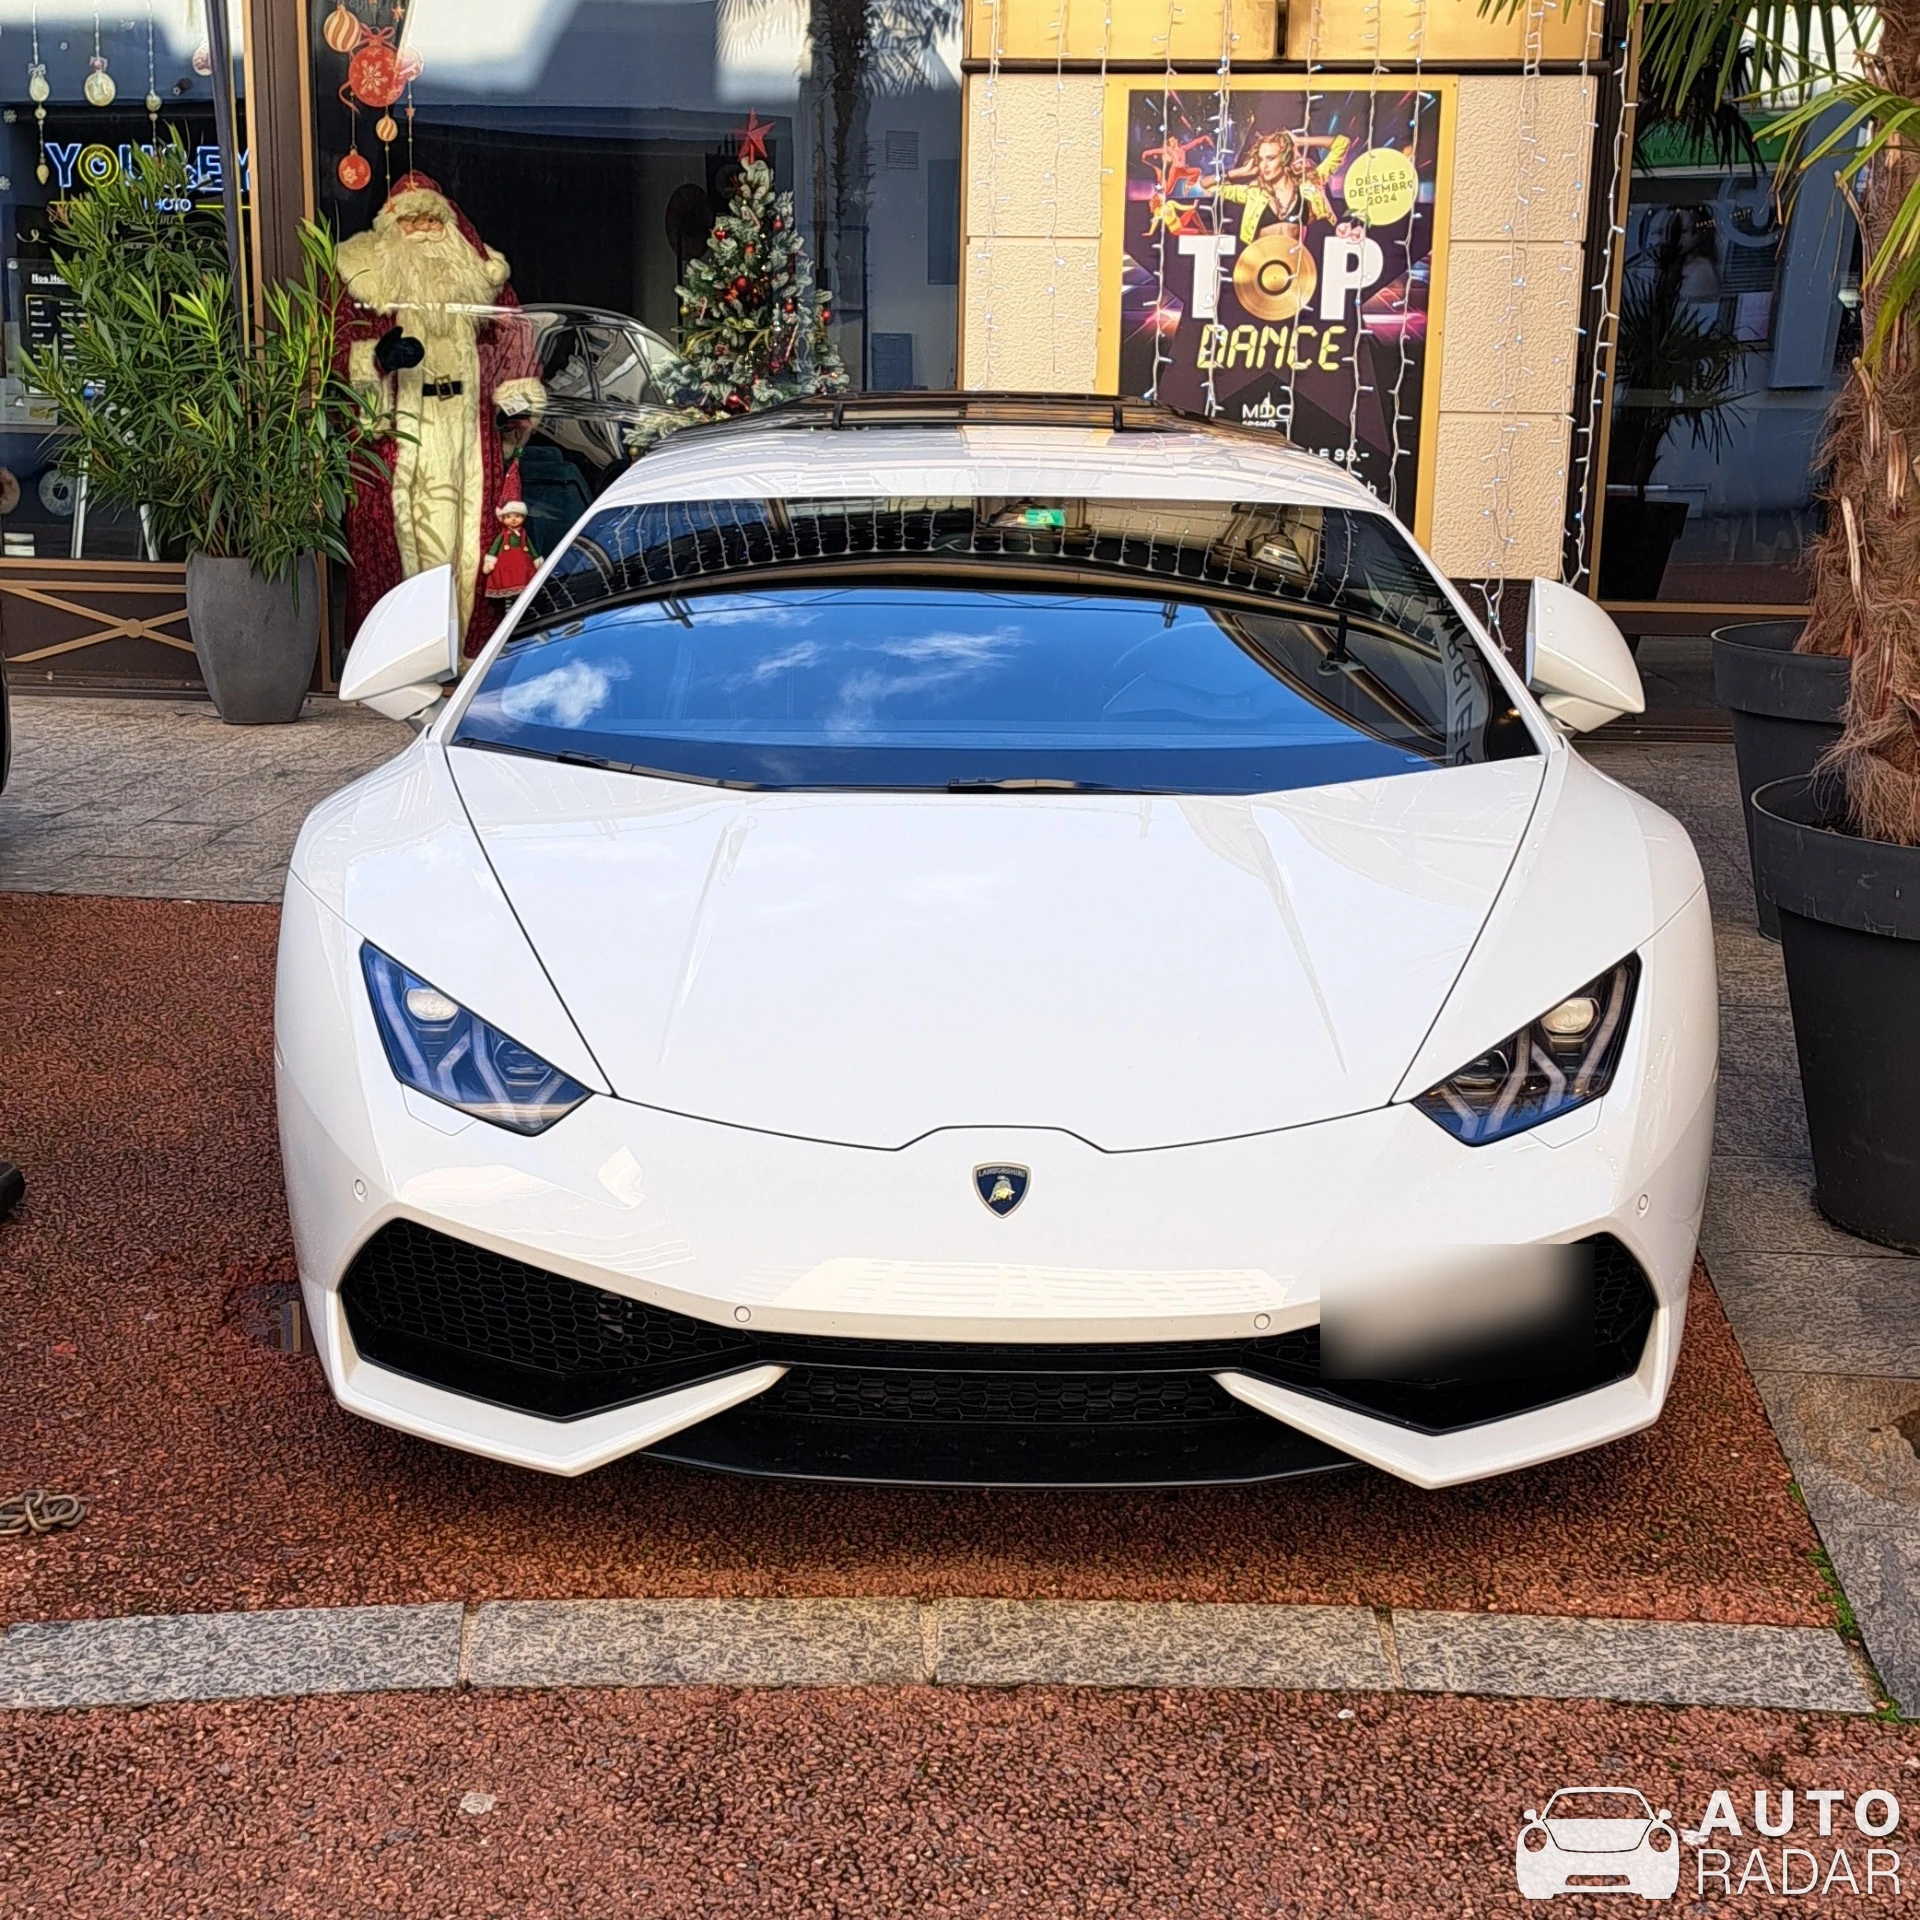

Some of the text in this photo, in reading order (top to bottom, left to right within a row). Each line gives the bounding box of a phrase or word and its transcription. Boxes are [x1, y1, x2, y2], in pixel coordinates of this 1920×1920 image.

[1399, 170, 1406, 180] 5
[1367, 193, 1398, 206] 2024
[1178, 234, 1384, 321] TOP
[1197, 324, 1347, 371] DANCE
